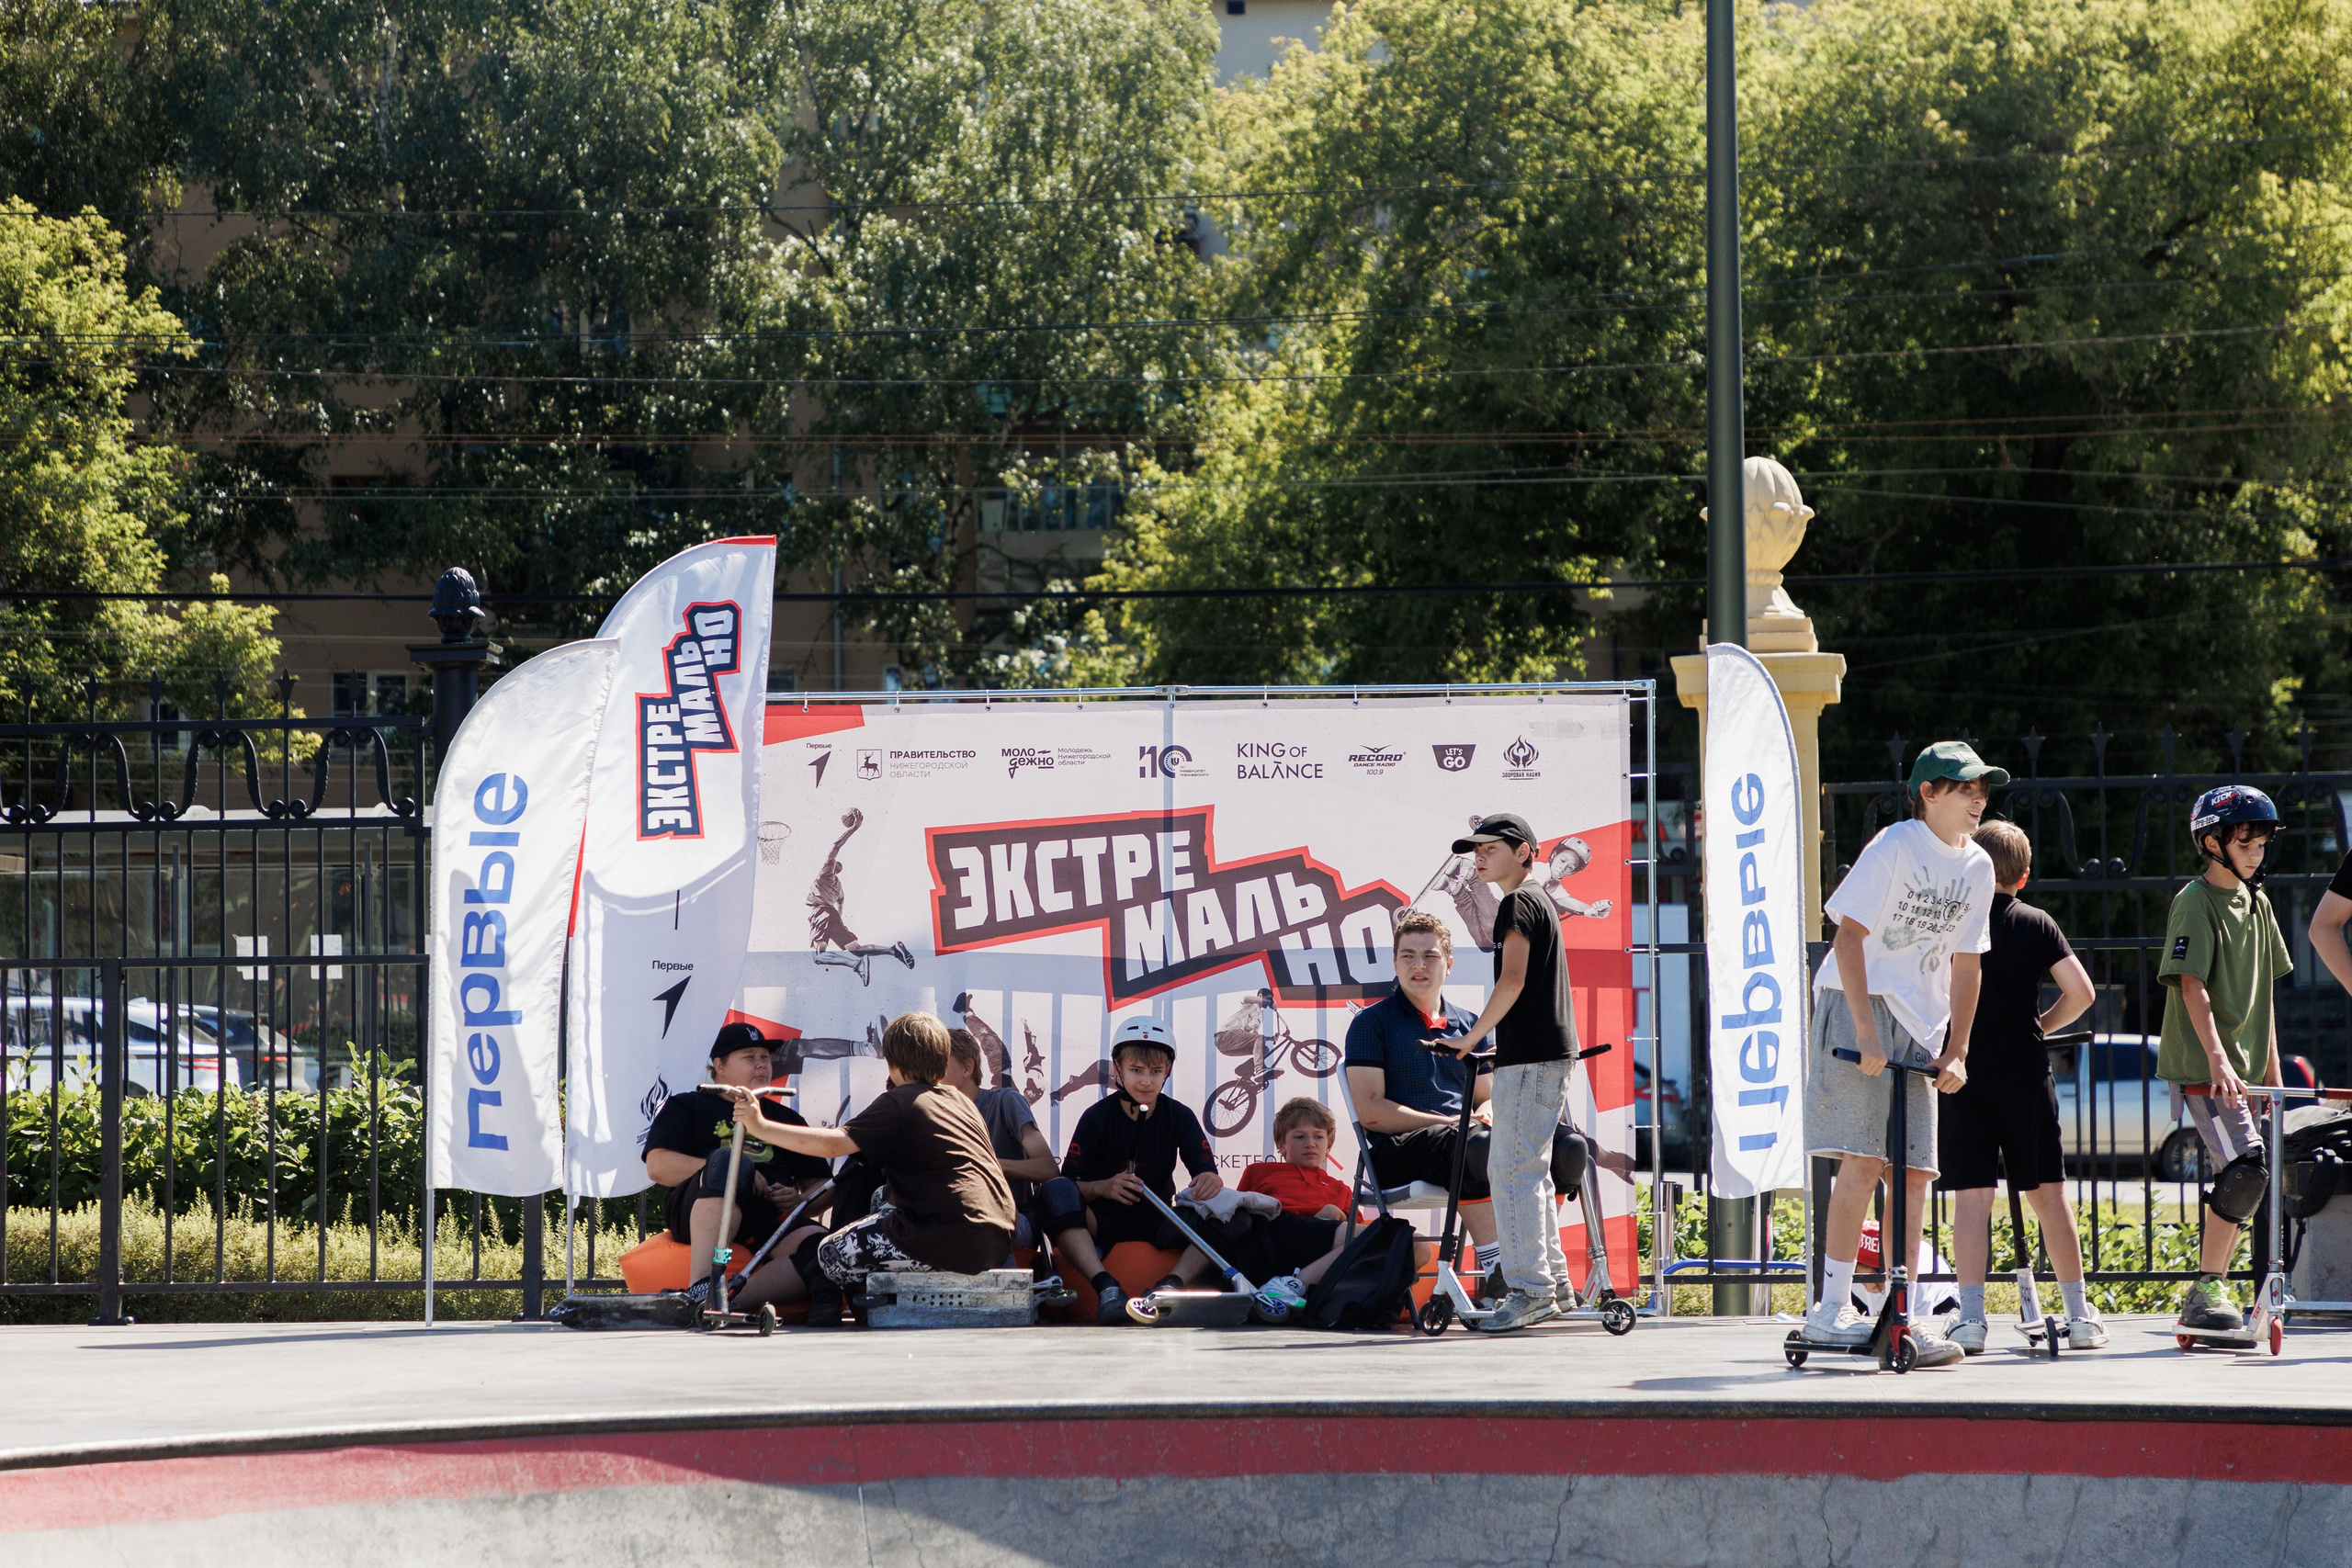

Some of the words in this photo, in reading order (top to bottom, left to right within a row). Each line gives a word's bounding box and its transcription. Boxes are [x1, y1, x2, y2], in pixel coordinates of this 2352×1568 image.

[693, 608, 734, 667] НО
[673, 640, 724, 744] МАЛЬ
[889, 750, 977, 760] ПРАВИТЕЛЬСТВО
[889, 761, 968, 770] НИЖЕГОРОДСКОЙ
[1237, 742, 1285, 758] KING
[1289, 746, 1307, 758] OF
[1442, 756, 1466, 769] GO
[1445, 748, 1464, 756] LET'S
[646, 703, 694, 835] ЭКСТРЕ
[2211, 791, 2233, 807] KICK
[948, 829, 1195, 931] ЭКСТРЕ
[1124, 871, 1328, 982] МАЛЬ
[1278, 903, 1397, 986] НО
[460, 773, 527, 1152] Первые
[651, 960, 695, 973] Первые
